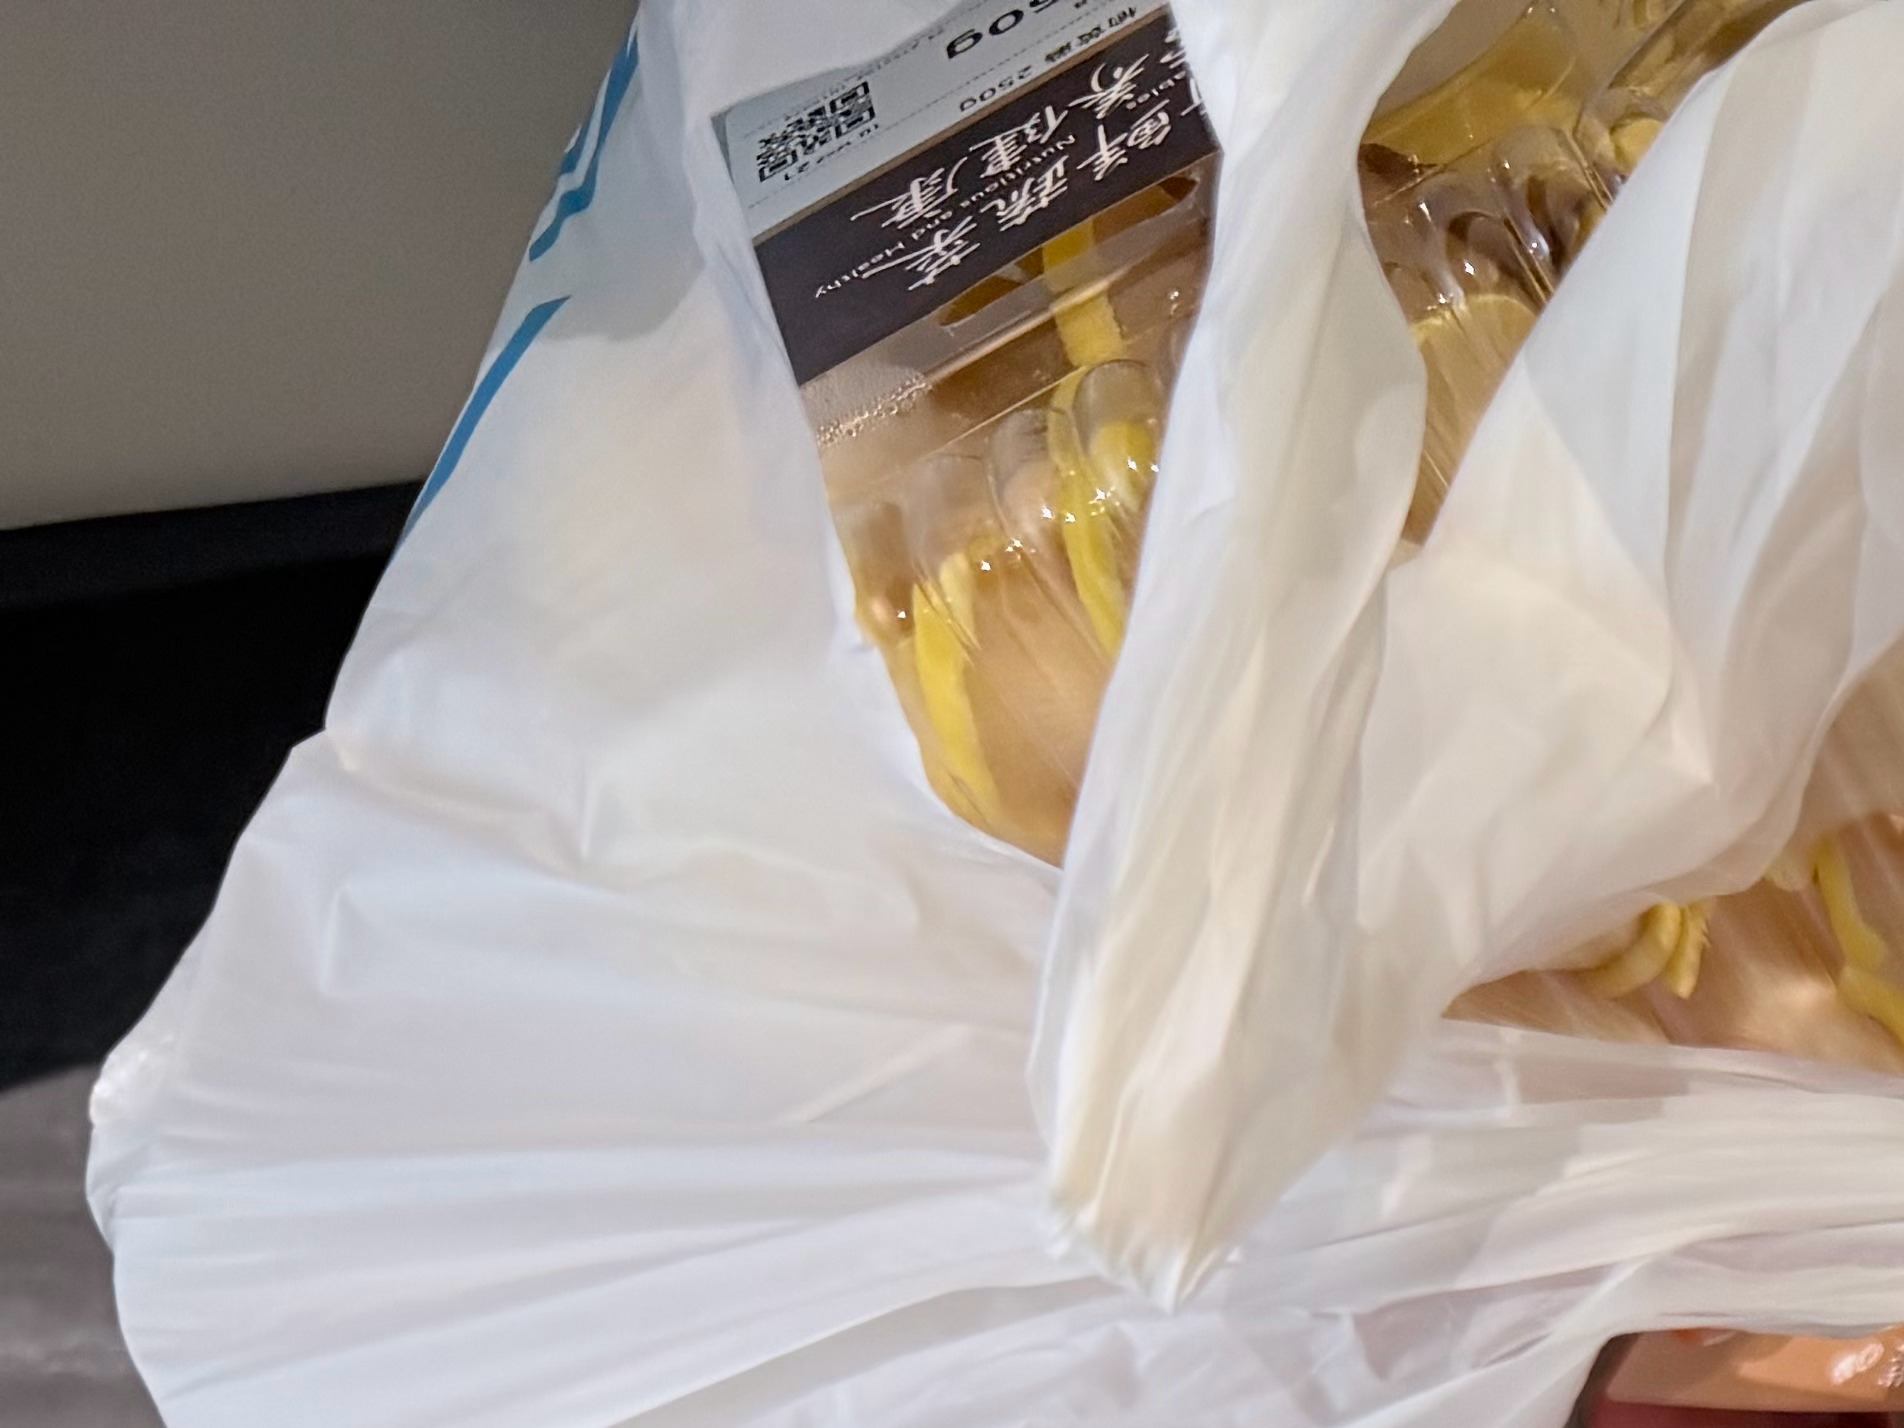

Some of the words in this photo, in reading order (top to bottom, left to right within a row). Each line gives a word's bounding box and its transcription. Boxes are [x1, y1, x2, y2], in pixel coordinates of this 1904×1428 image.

[959, 135, 1077, 208] Nutritious
[911, 210, 954, 241] and
[814, 241, 907, 299] Healthy
